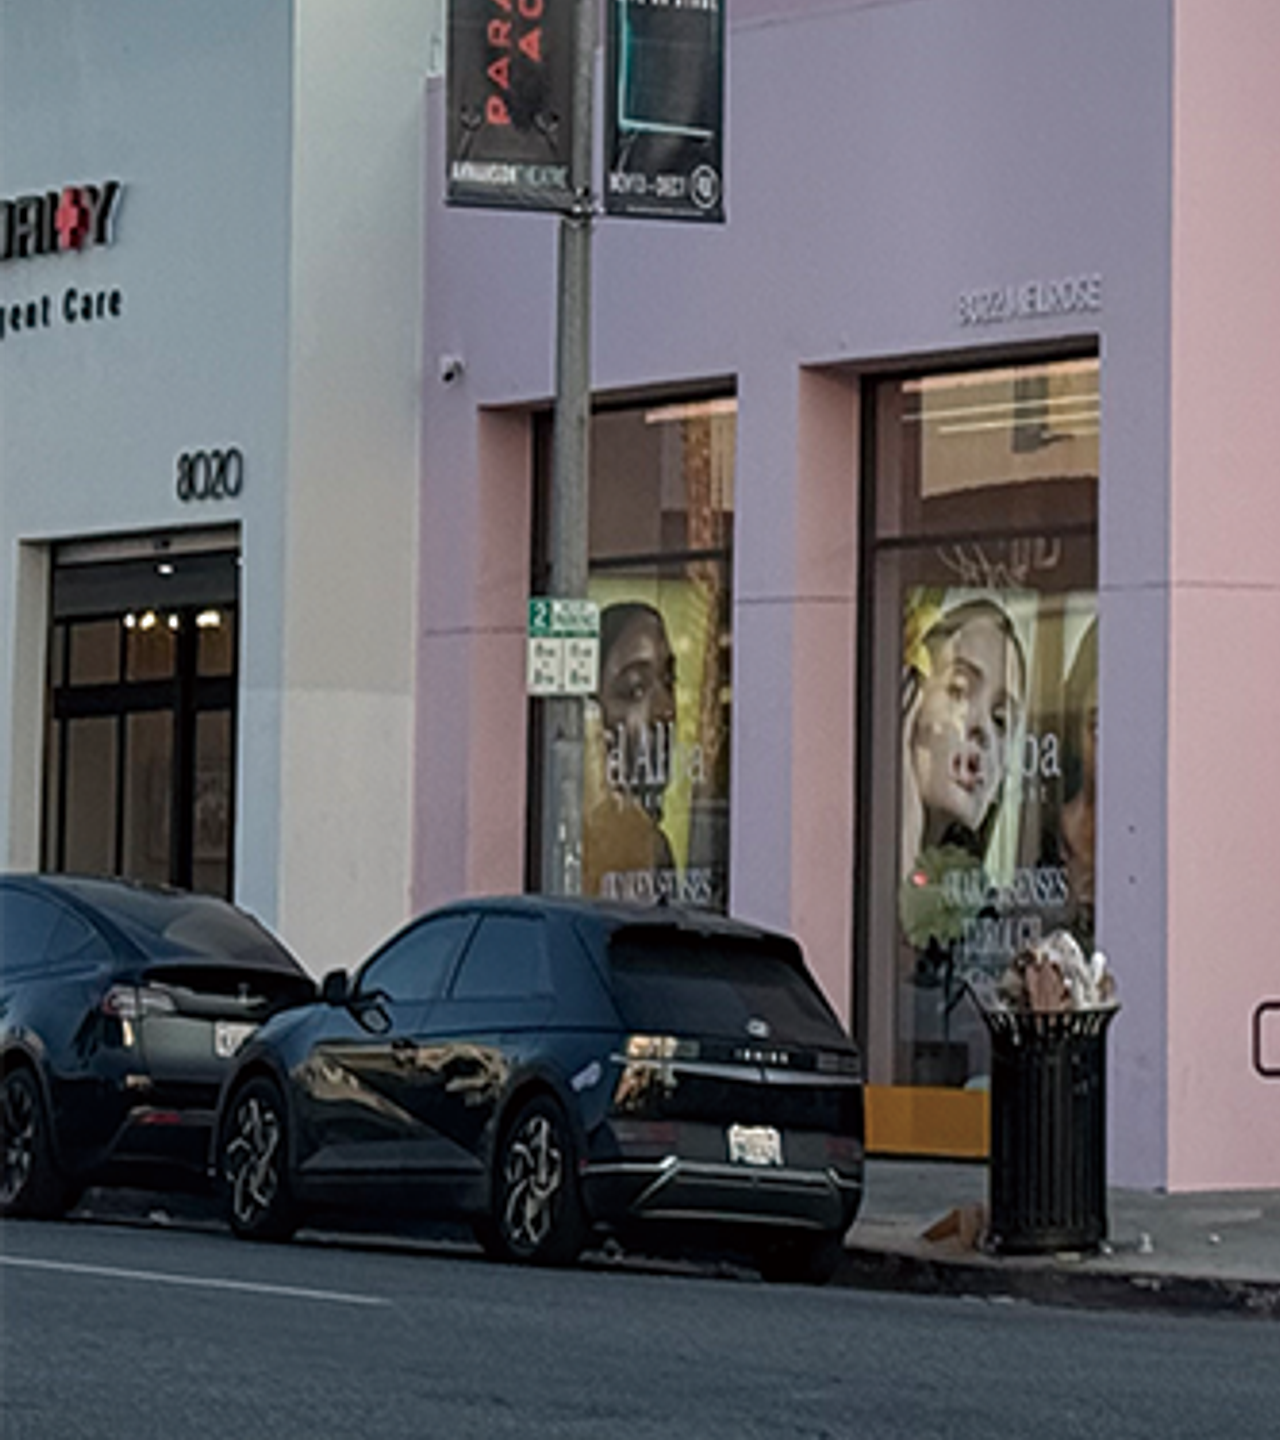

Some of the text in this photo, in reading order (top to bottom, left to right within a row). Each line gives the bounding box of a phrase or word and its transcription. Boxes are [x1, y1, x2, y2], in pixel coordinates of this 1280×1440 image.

[63, 287, 121, 323] Care
[177, 447, 243, 503] 8020
[533, 601, 547, 628] 2
